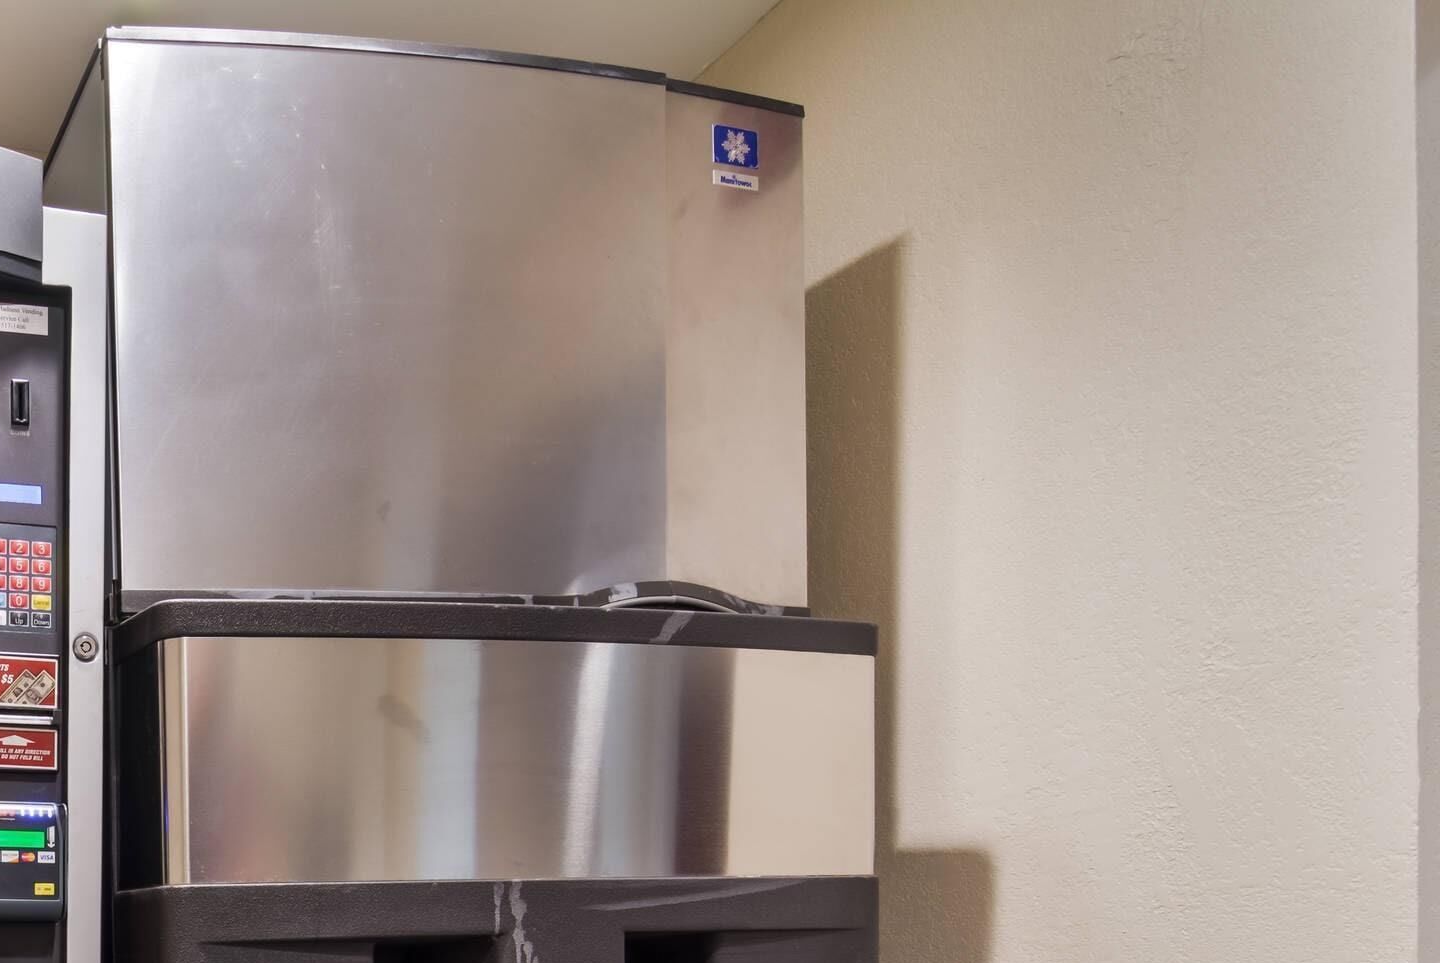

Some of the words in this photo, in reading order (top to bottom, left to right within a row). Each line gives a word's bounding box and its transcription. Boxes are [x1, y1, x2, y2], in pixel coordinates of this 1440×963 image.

[17, 543, 23, 553] 2
[38, 544, 45, 555] 3
[16, 561, 22, 570] 5
[38, 562, 45, 572] 6
[16, 578, 23, 588] 8
[38, 580, 45, 590] 9
[16, 596, 22, 606] 0
[1, 674, 14, 684] $5
